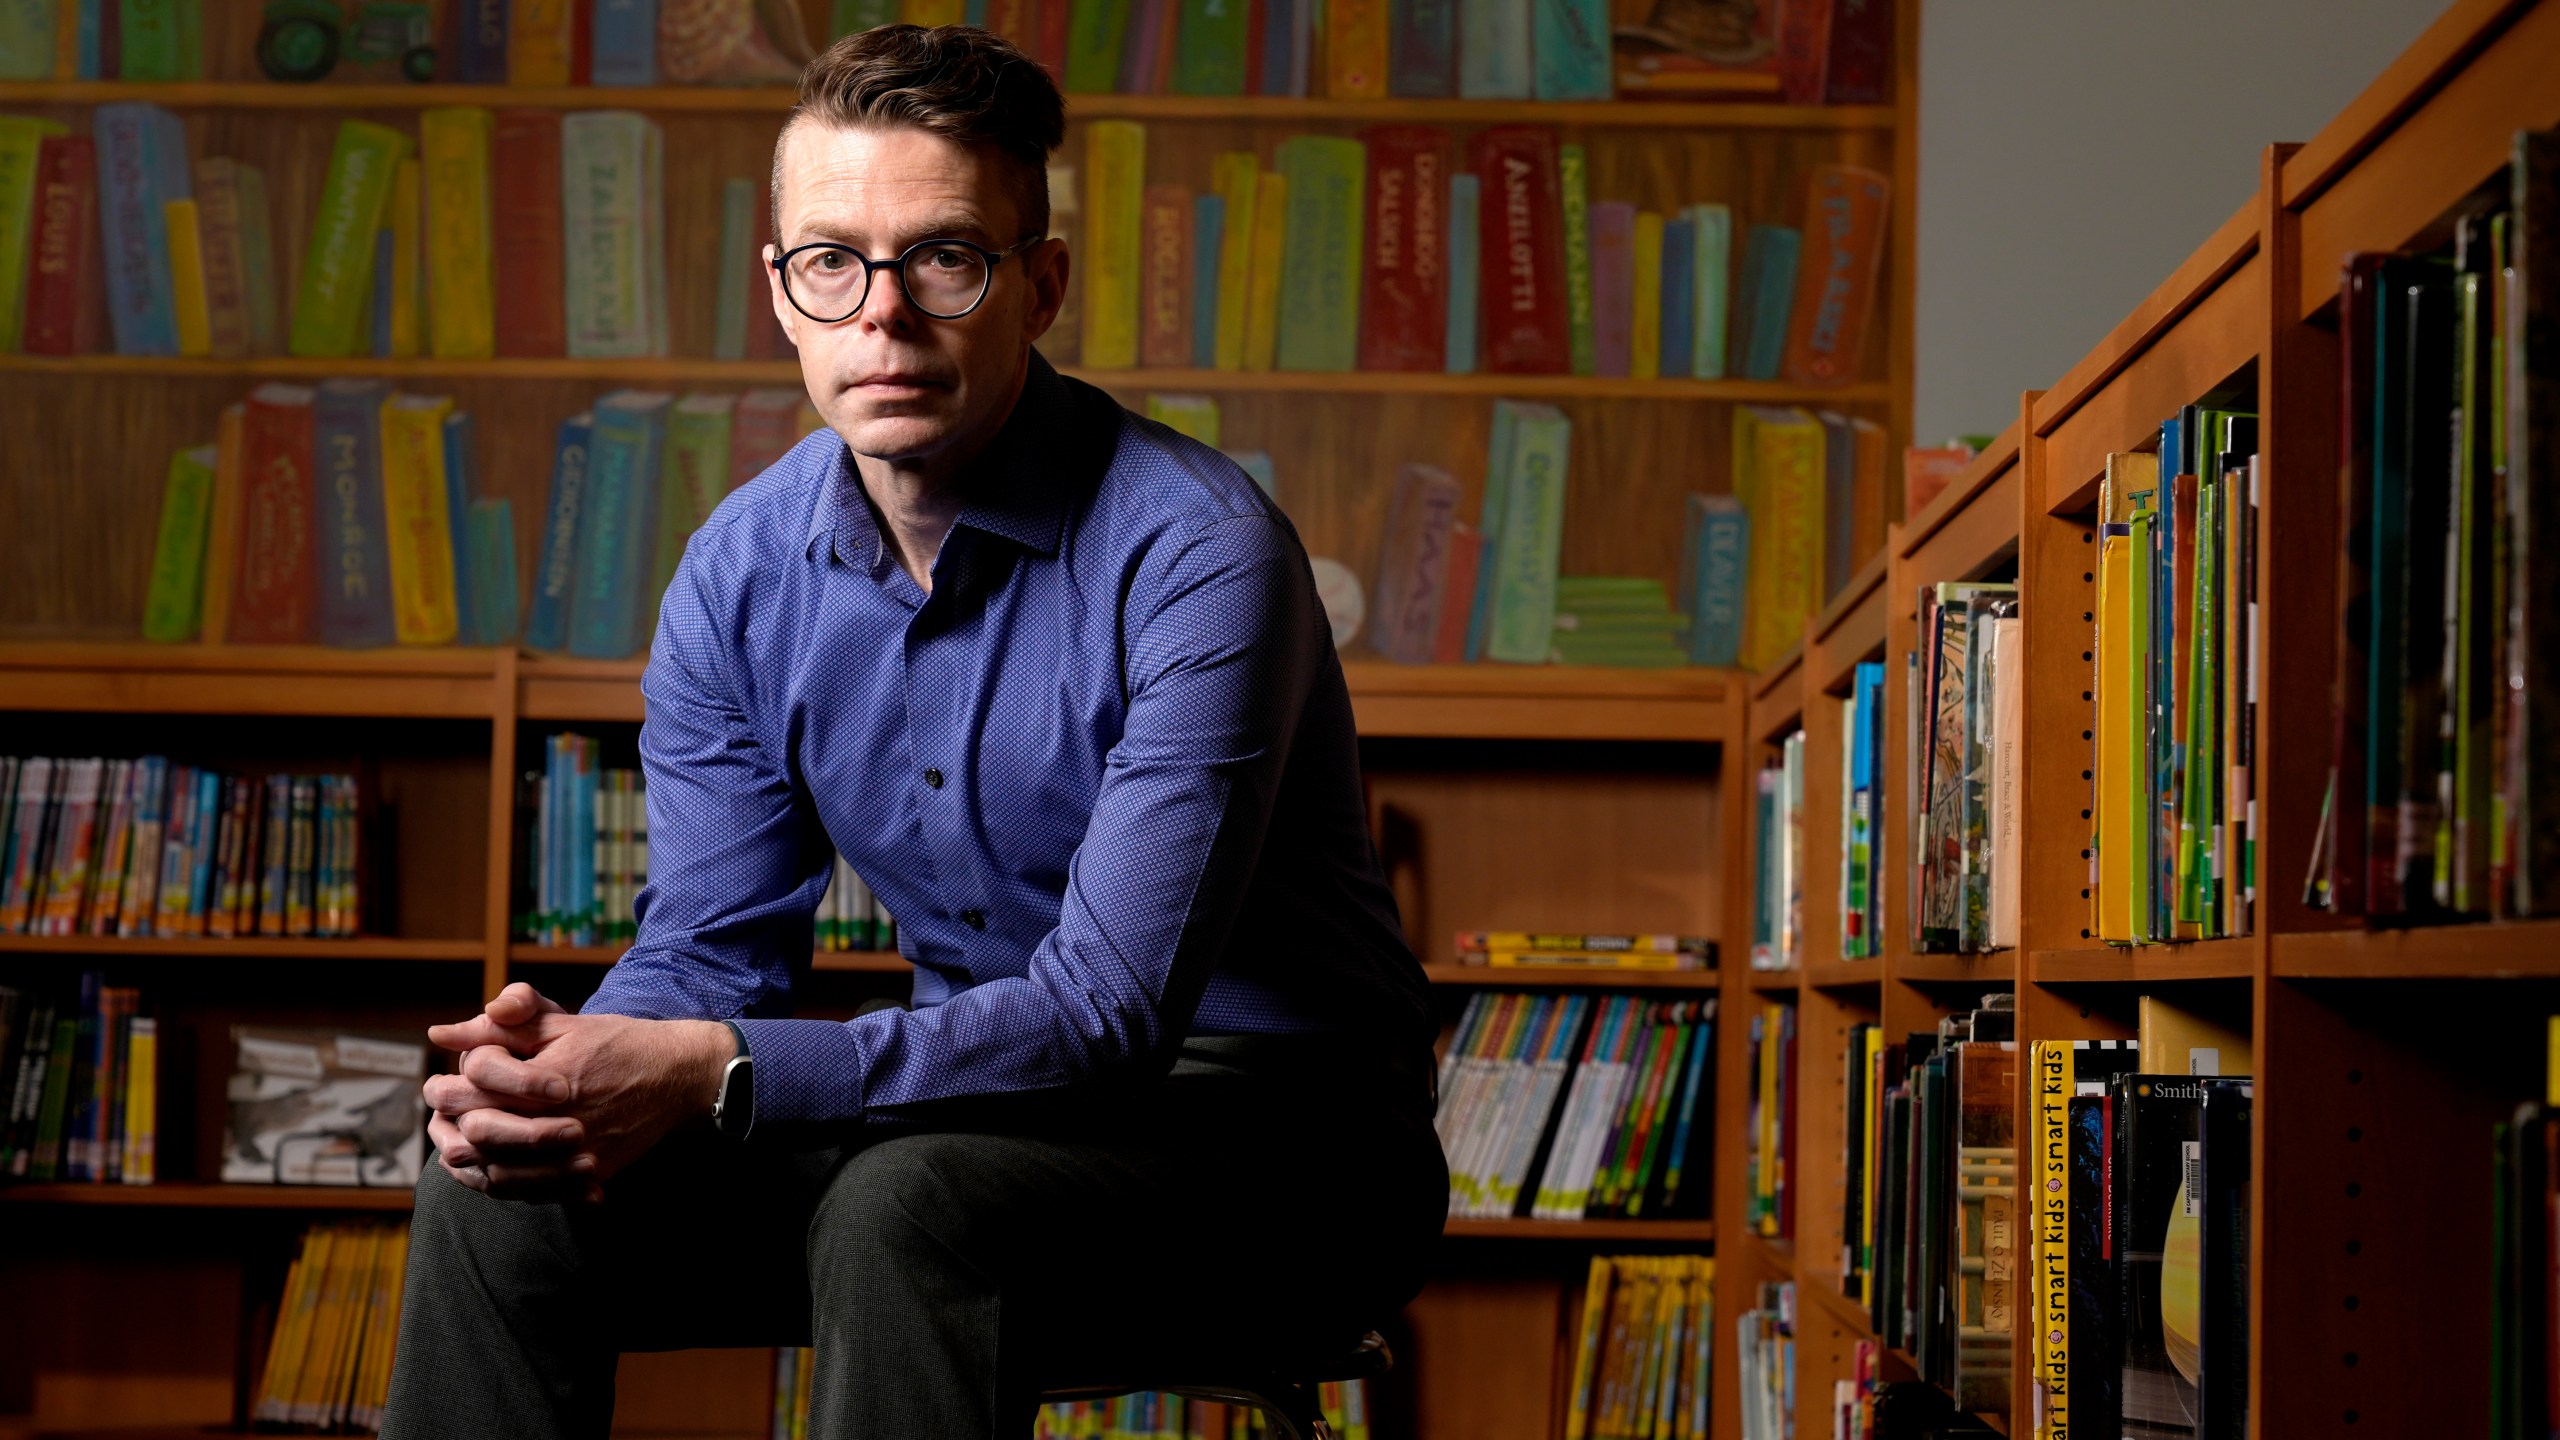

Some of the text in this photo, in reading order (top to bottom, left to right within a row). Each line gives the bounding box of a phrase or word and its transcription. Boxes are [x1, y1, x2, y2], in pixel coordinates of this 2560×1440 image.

[38, 182, 74, 274] LOUIS
[329, 433, 369, 599] MONROE
[1401, 495, 1456, 636] HAAS
[2003, 742, 2012, 779] Harcourt,
[2004, 781, 2012, 801] Brace
[2004, 802, 2011, 810] &
[2003, 811, 2012, 838] World,
[2043, 1050, 2063, 1094] kids
[2043, 1103, 2063, 1172] smart
[1993, 1209, 2004, 1241] PAUL
[2044, 1199, 2064, 1243] kids
[1991, 1260, 2005, 1320] ZELINSKY
[2045, 1252, 2065, 1322] smart
[2047, 1351, 2066, 1394] kids
